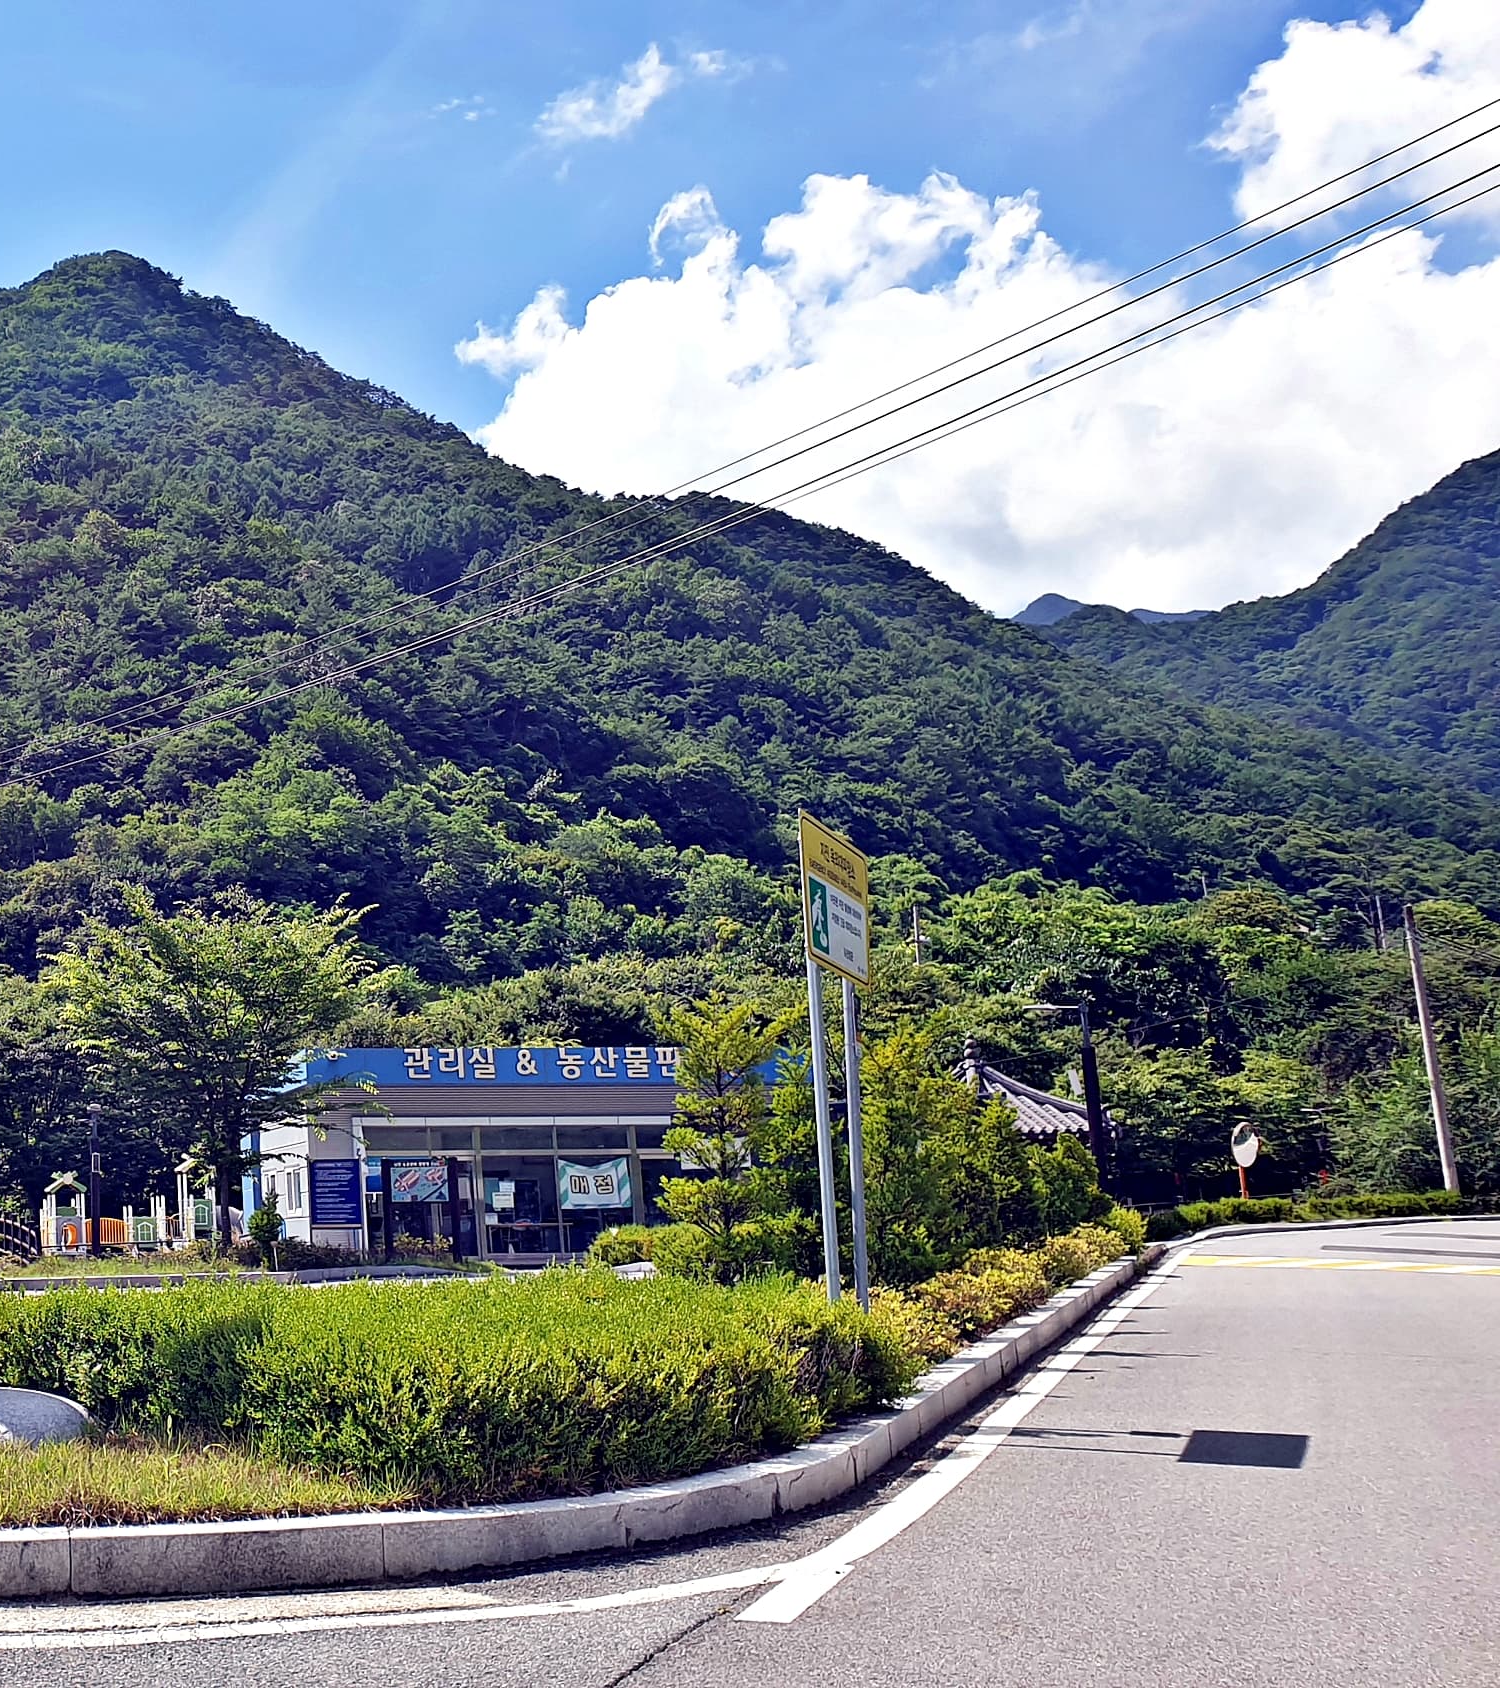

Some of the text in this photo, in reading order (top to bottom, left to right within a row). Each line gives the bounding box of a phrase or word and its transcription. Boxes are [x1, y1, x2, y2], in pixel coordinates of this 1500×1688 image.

[403, 1046, 683, 1079] 관리실 & 농산물판
[569, 1175, 615, 1194] 매점
